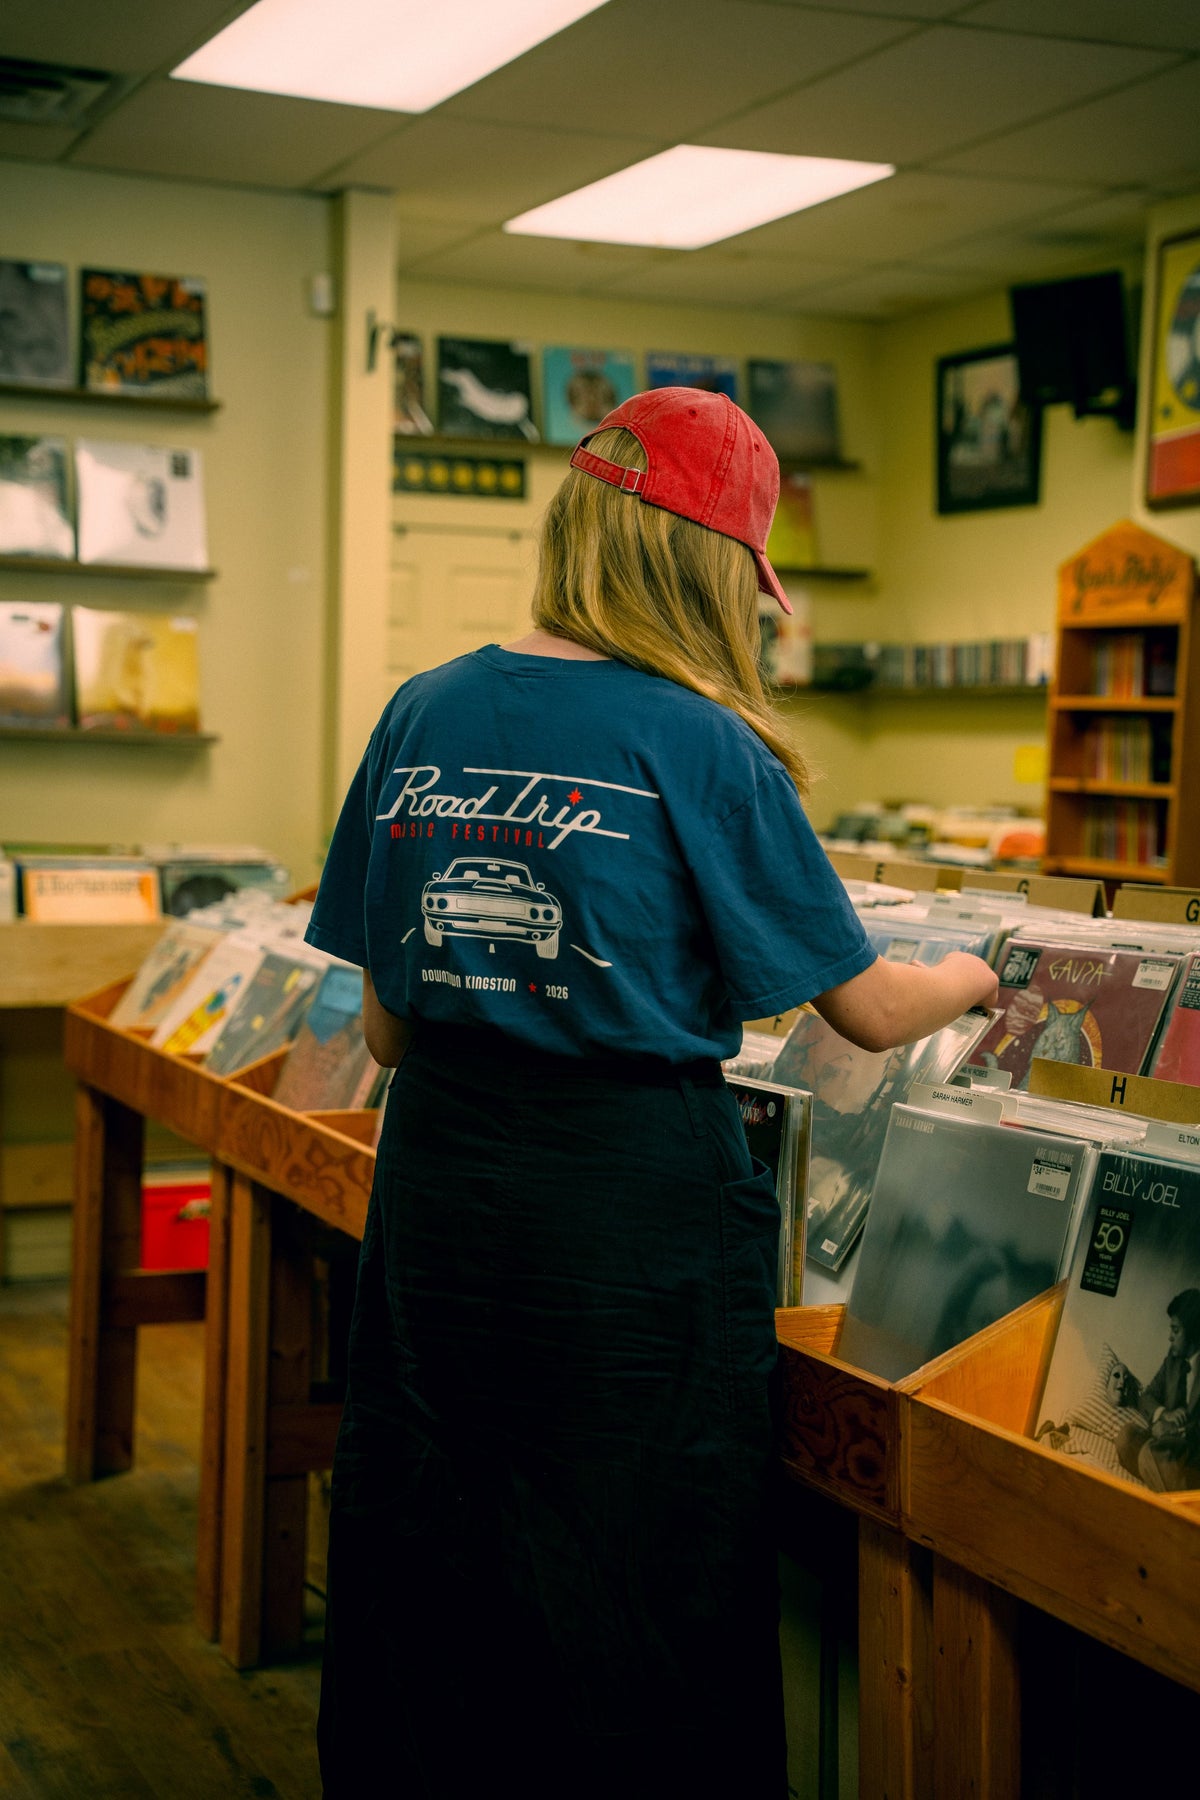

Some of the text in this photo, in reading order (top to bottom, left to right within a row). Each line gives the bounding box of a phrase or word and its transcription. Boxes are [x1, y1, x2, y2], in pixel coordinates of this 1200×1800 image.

[376, 765, 660, 850] Road Trip
[452, 823, 545, 848] FESTIVAL
[465, 975, 517, 993] KINGSTON
[545, 984, 569, 1000] 2026
[931, 1091, 950, 1102] SARAH
[950, 1094, 974, 1107] HARMER
[1110, 1076, 1127, 1104] H
[1178, 1134, 1200, 1146] ELTON
[1102, 1171, 1181, 1208] BILLY JOEL
[1100, 1208, 1131, 1221] BILLY JOEL
[1093, 1222, 1124, 1252] 50
